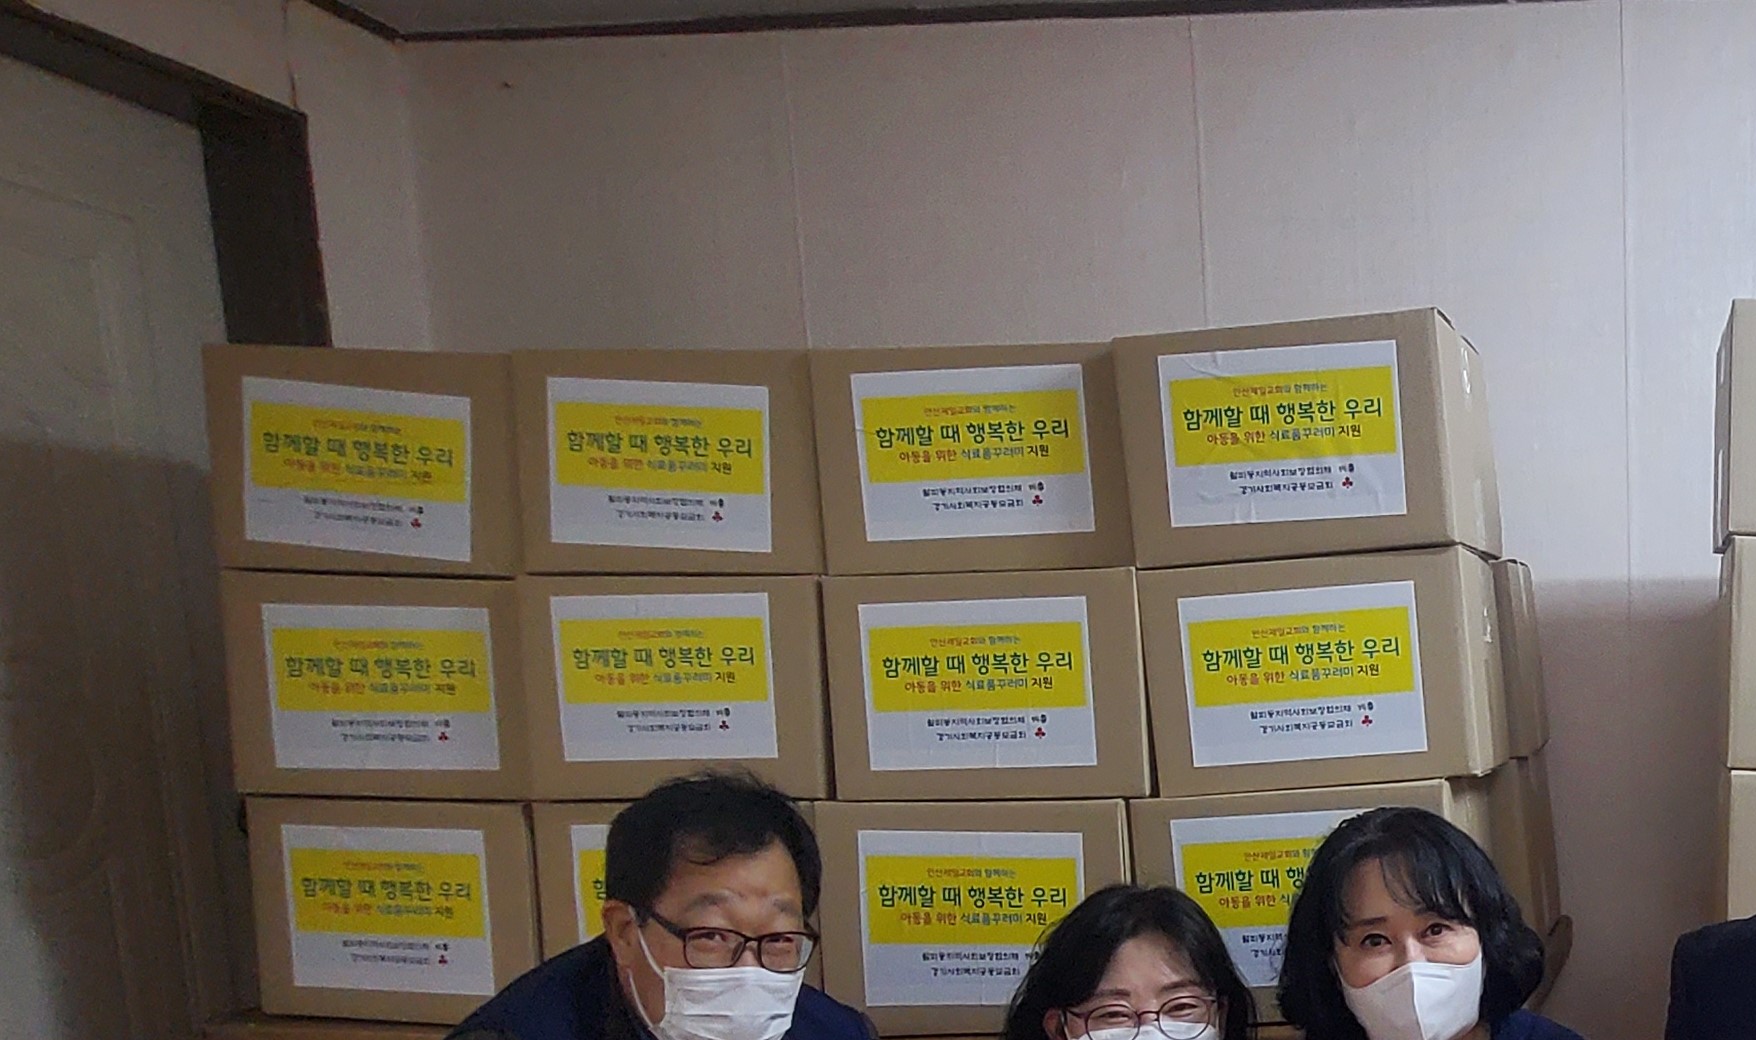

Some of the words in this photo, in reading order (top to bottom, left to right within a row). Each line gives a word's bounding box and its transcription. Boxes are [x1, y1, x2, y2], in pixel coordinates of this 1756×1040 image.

[1182, 405, 1244, 431] 함께할
[1249, 404, 1269, 425] 때
[1275, 398, 1337, 425] 행복한
[1343, 397, 1381, 420] 우리
[566, 429, 623, 454] 함께할
[628, 434, 648, 453] 때
[653, 433, 710, 458] 행복한
[716, 437, 751, 459] 우리
[875, 424, 935, 449] 함께할
[939, 424, 960, 444] 때
[965, 419, 1026, 444] 행복한
[1030, 418, 1069, 440] 우리
[1242, 430, 1266, 445] 위한
[1337, 424, 1361, 438] 지원
[262, 430, 321, 457] 함께할
[326, 437, 346, 457] 때
[351, 439, 410, 465] 행복한
[415, 445, 453, 468] 우리
[572, 647, 629, 669] 함께할
[633, 648, 653, 667] 때
[658, 646, 713, 668] 행복한
[719, 646, 754, 666] 우리
[881, 654, 940, 678] 함께할
[946, 654, 965, 674] 때
[971, 651, 1030, 675] 행복한
[1035, 651, 1072, 672] 우리
[1201, 645, 1263, 672] 함께할
[1268, 644, 1289, 665] 때
[1294, 638, 1355, 665] 행복한
[1360, 636, 1399, 659] 우리
[940, 679, 962, 692] 위한
[1031, 676, 1053, 689] 지원
[1262, 670, 1285, 684] 위한
[1356, 662, 1379, 677] 지원
[1194, 869, 1255, 894] 함께할
[1260, 868, 1280, 889] 때
[878, 884, 937, 908] 함께할
[942, 885, 961, 907] 때
[967, 885, 1024, 909] 행복한
[1030, 887, 1066, 908] 우리
